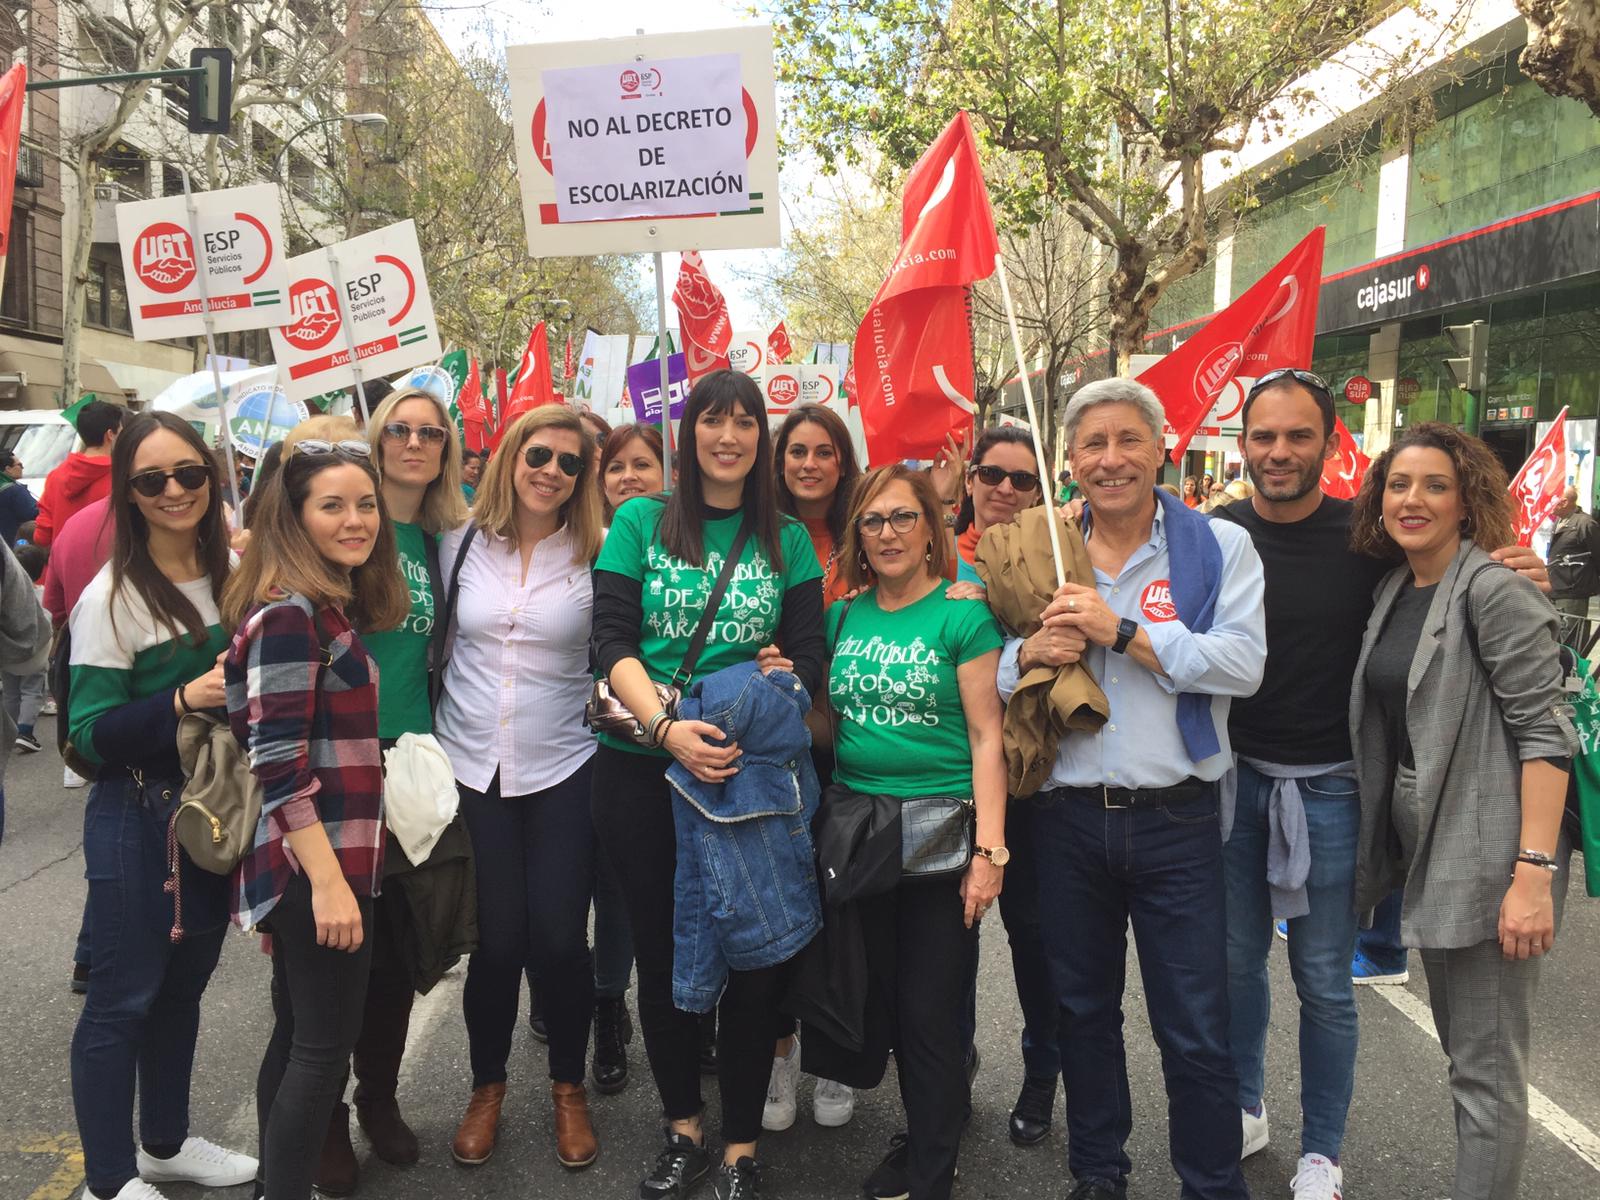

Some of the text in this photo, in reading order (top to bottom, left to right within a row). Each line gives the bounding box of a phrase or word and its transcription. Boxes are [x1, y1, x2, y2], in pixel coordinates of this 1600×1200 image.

[568, 107, 731, 138] NO AL DECRETO
[639, 147, 665, 166] DE
[569, 171, 743, 204] ESCOLARIZACIÓN
[141, 232, 188, 264] UGT
[207, 252, 242, 264] Servicios
[209, 264, 242, 275] Públicos
[1357, 275, 1415, 311] cajasur
[351, 295, 385, 312] Servicios
[353, 308, 386, 323] Públicos
[872, 307, 896, 407] dalucia.com
[1348, 381, 1367, 391] caja
[664, 589, 696, 608] DE
[1146, 585, 1172, 602] UG
